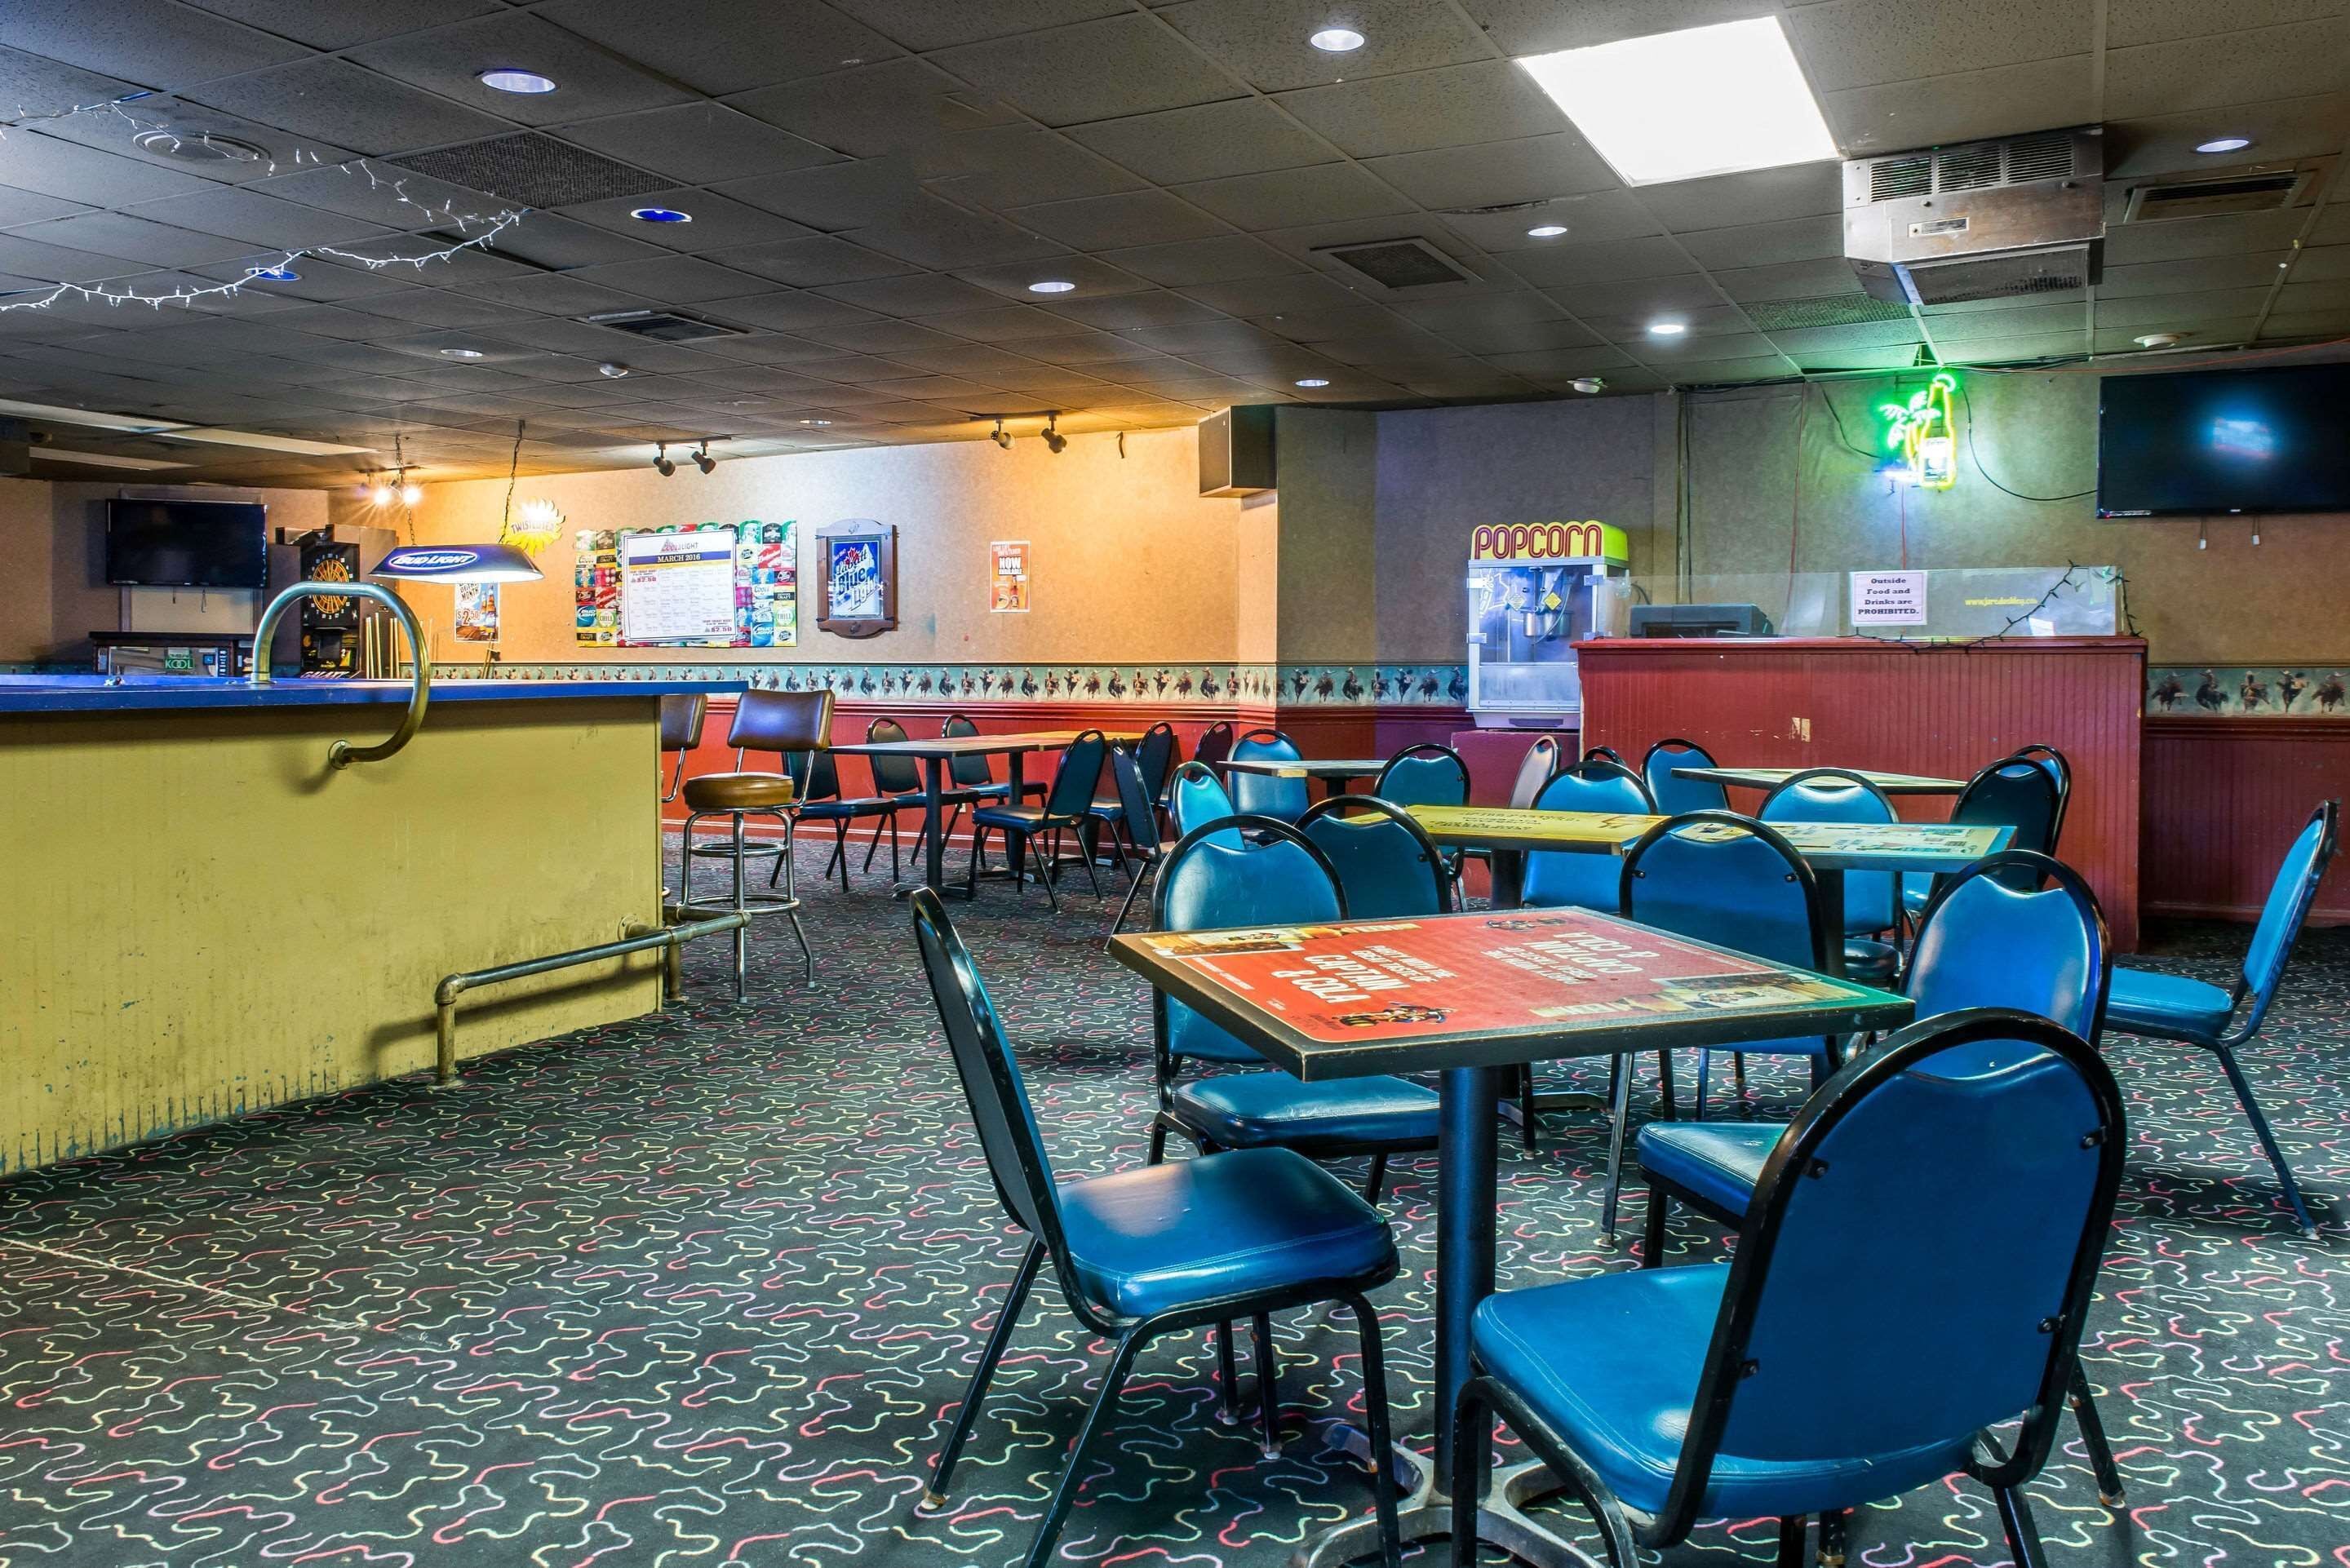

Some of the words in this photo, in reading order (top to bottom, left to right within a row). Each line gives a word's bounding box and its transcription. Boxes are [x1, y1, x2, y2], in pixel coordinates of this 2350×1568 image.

[682, 542, 699, 550] LIGHT
[1474, 525, 1603, 560] POPCORN
[393, 556, 429, 565] BUD
[428, 555, 475, 564] LIGHT
[657, 555, 685, 563] MARCH
[685, 553, 701, 561] 2016
[999, 556, 1022, 569] NOW
[838, 566, 867, 596] Blue
[165, 659, 193, 669] KOOL
[1554, 932, 1632, 951] COLA
[1523, 941, 1643, 973] CAPTAIN
[1305, 955, 1410, 990] CAPTAIN
[1292, 977, 1370, 1003] COLA
